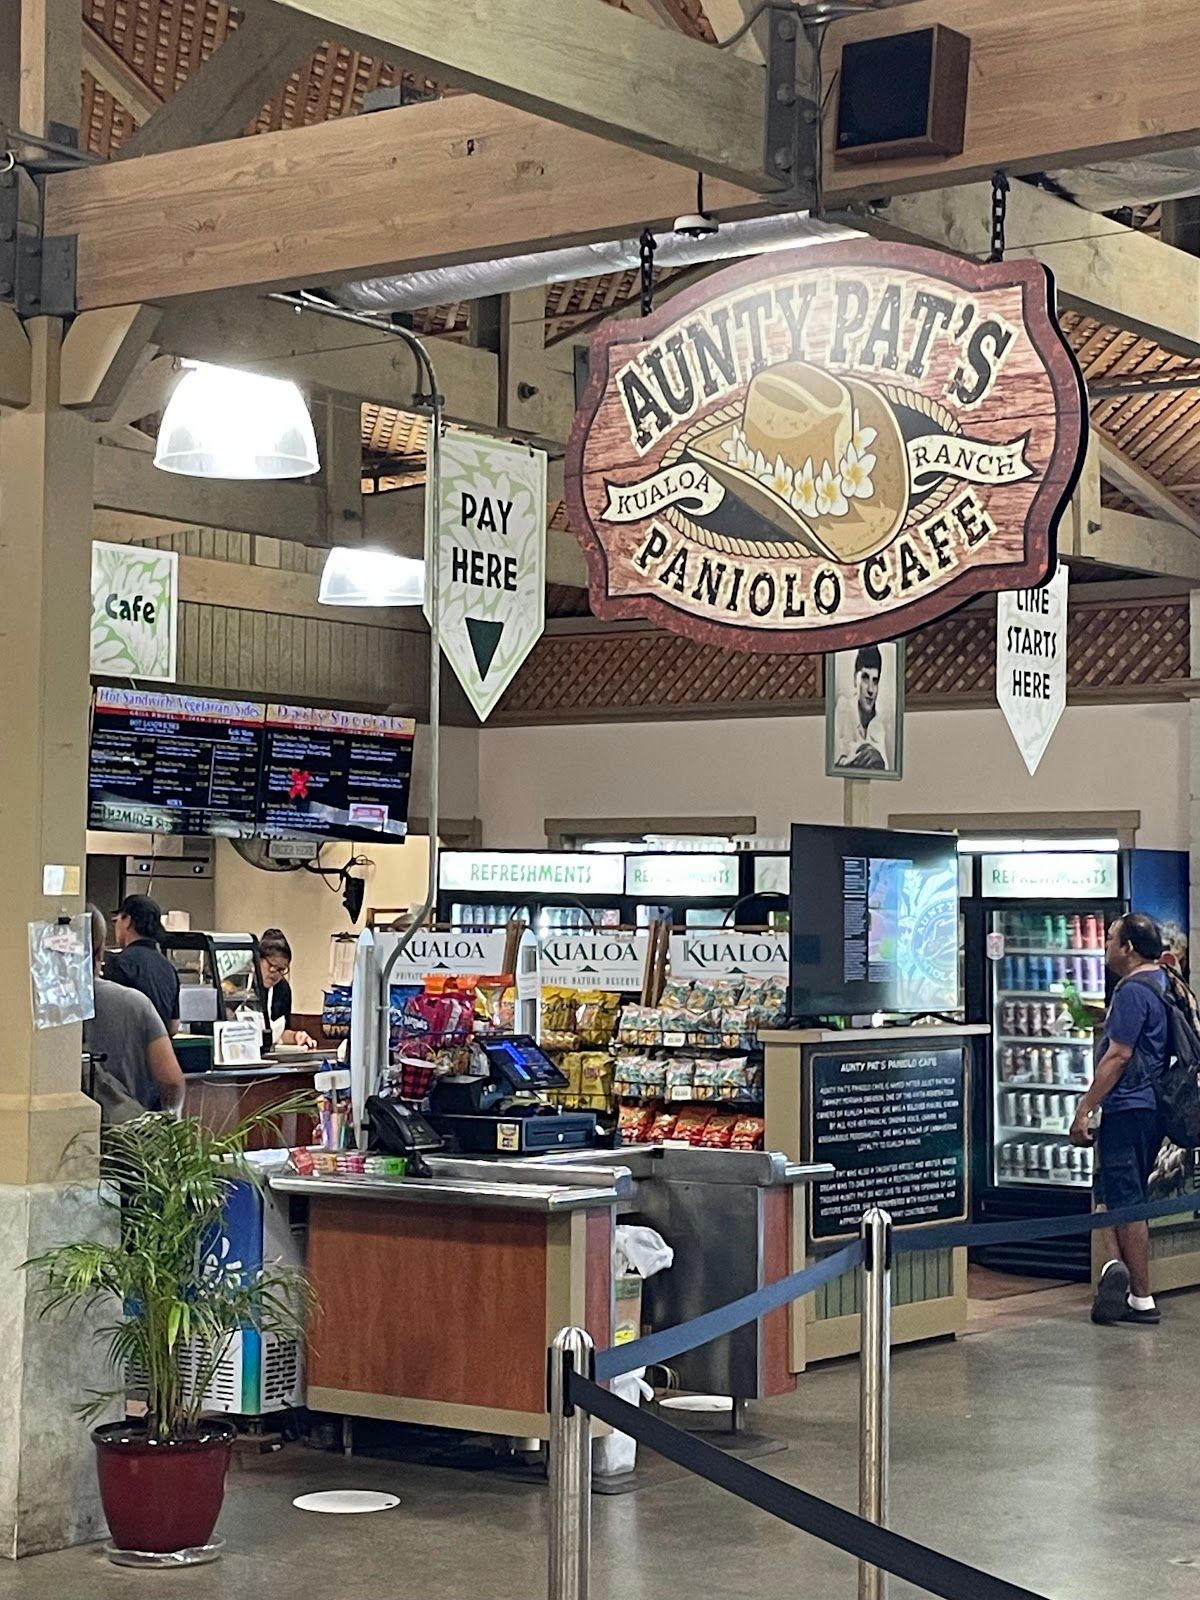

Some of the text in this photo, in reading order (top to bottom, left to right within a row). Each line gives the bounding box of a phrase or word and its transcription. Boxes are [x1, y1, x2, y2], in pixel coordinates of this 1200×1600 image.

[620, 280, 1014, 450] AUNTY PAT'S
[912, 447, 1017, 477] RANCH
[617, 471, 713, 516] KUALOA
[461, 492, 513, 536] PAY
[451, 546, 518, 592] HERE
[636, 495, 993, 617] PANIOLO CAFE
[105, 593, 155, 624] Cafe
[1007, 625, 1057, 659] STARTS
[1012, 669, 1050, 699] HERE
[331, 711, 405, 729] Specials
[470, 863, 591, 883] REFRESHMENTS
[538, 939, 639, 967] KUALOA
[683, 940, 788, 968] KUALOA
[606, 977, 640, 987] RESERVE
[840, 1061, 865, 1072] AUNTY
[918, 1057, 936, 1067] CAFE
